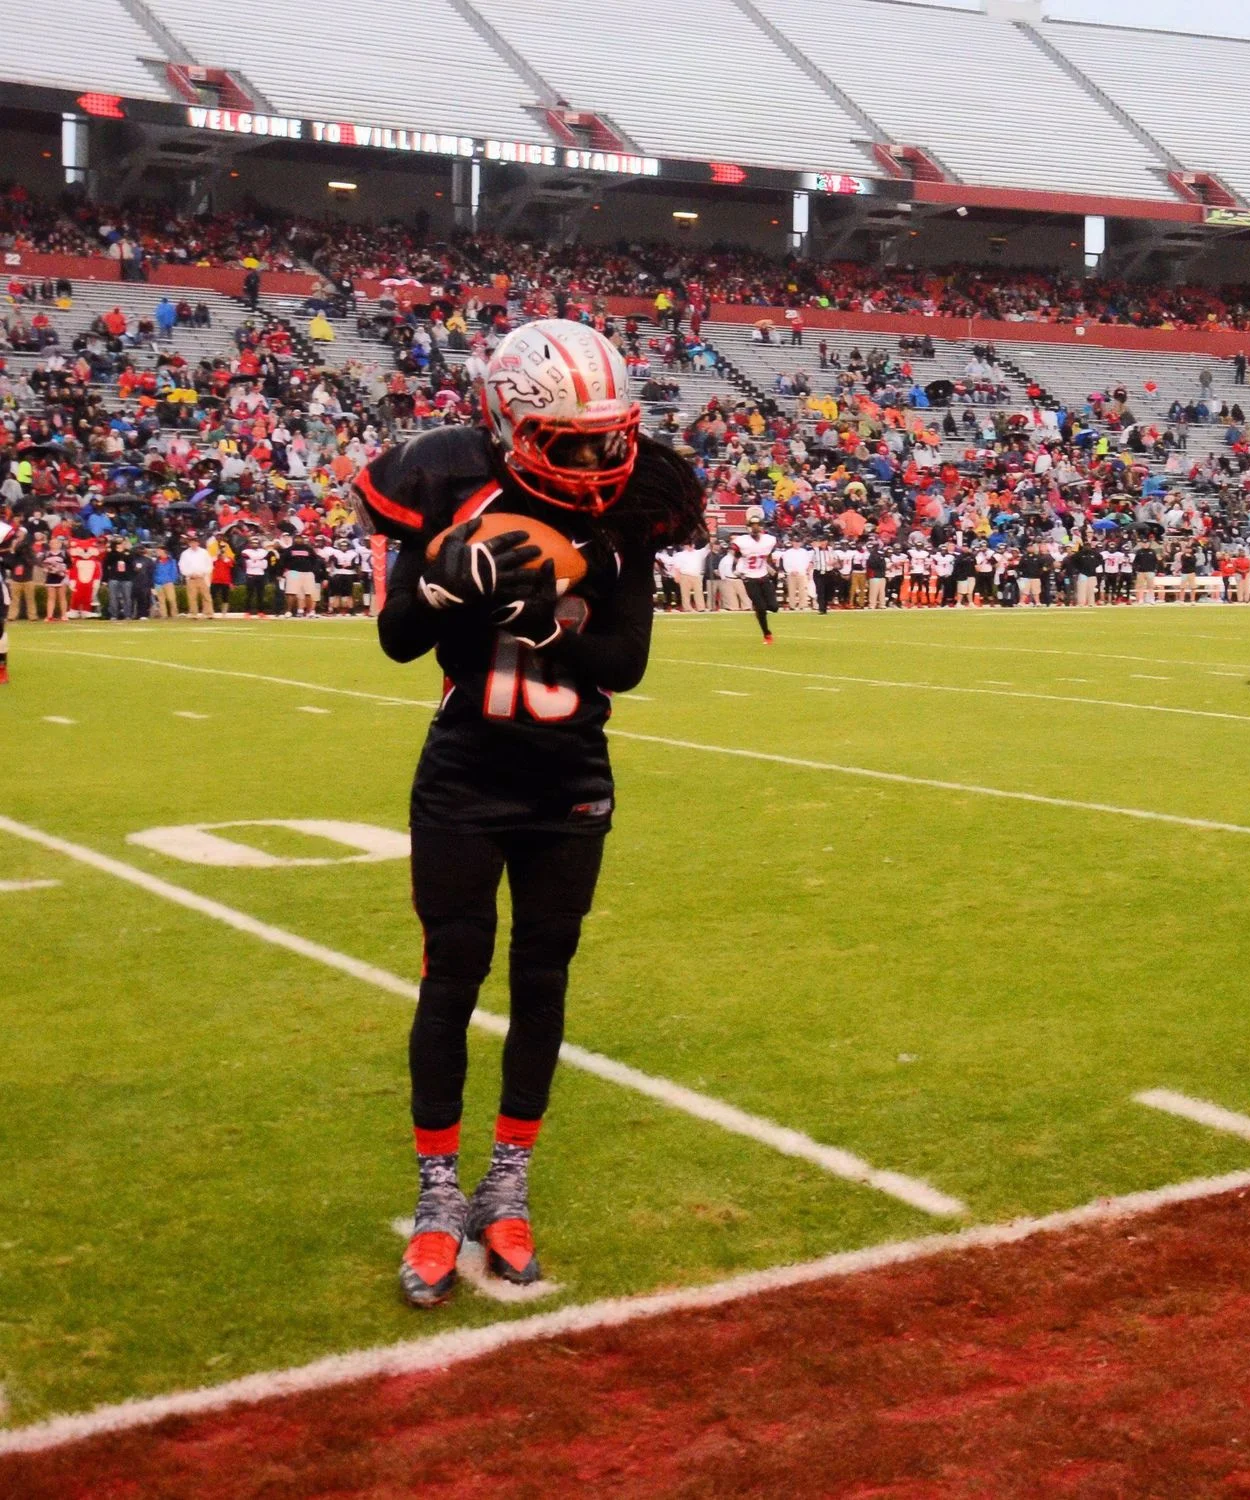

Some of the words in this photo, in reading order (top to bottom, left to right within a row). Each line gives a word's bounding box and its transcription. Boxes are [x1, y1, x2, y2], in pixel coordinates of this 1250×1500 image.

[187, 107, 302, 139] WELCOME
[312, 121, 341, 143] TO
[354, 125, 556, 166] WILLIAMS-BRICE
[564, 149, 659, 176] STADIUM
